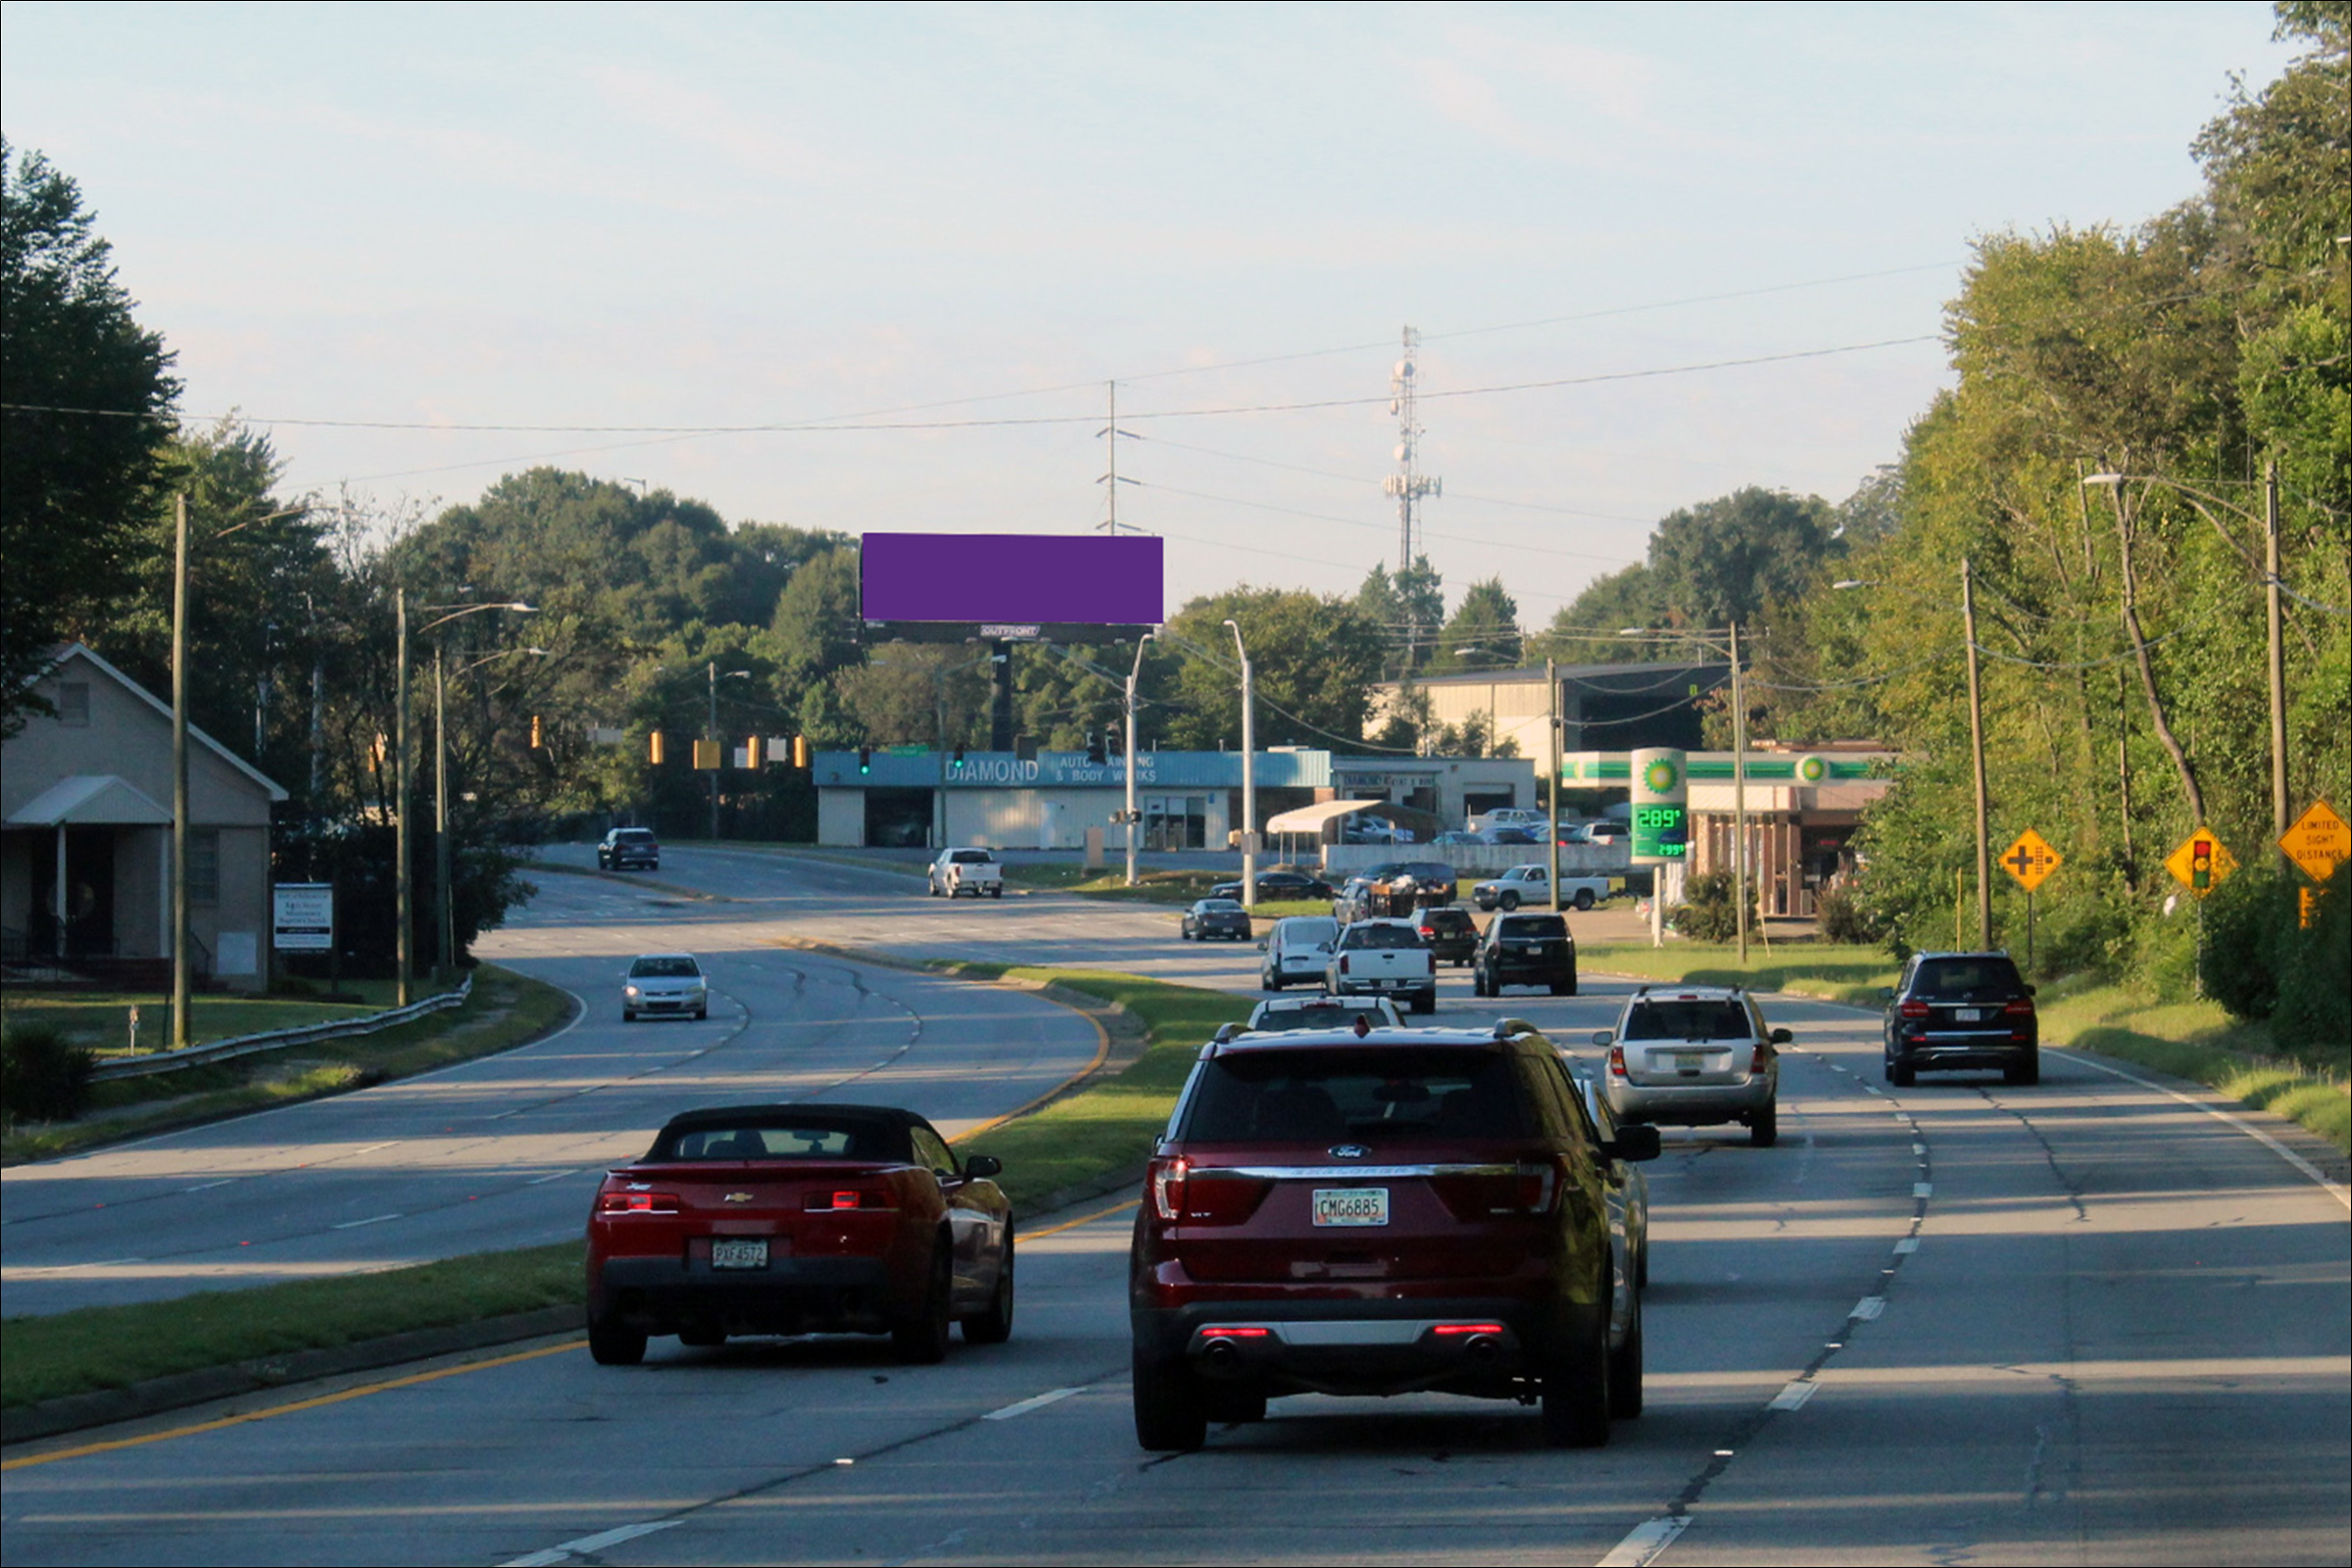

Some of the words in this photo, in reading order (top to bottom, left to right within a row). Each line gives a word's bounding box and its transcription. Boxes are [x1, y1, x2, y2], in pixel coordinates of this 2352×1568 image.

[945, 760, 1039, 781] DIAMOND
[1072, 770, 1103, 781] BODY
[2301, 820, 2339, 830] LIMITED
[2306, 835, 2334, 845] SIGHT
[2296, 849, 2344, 860] DISTANCE
[1337, 1146, 1362, 1157] Ford
[1320, 1199, 1379, 1216] CMG6885
